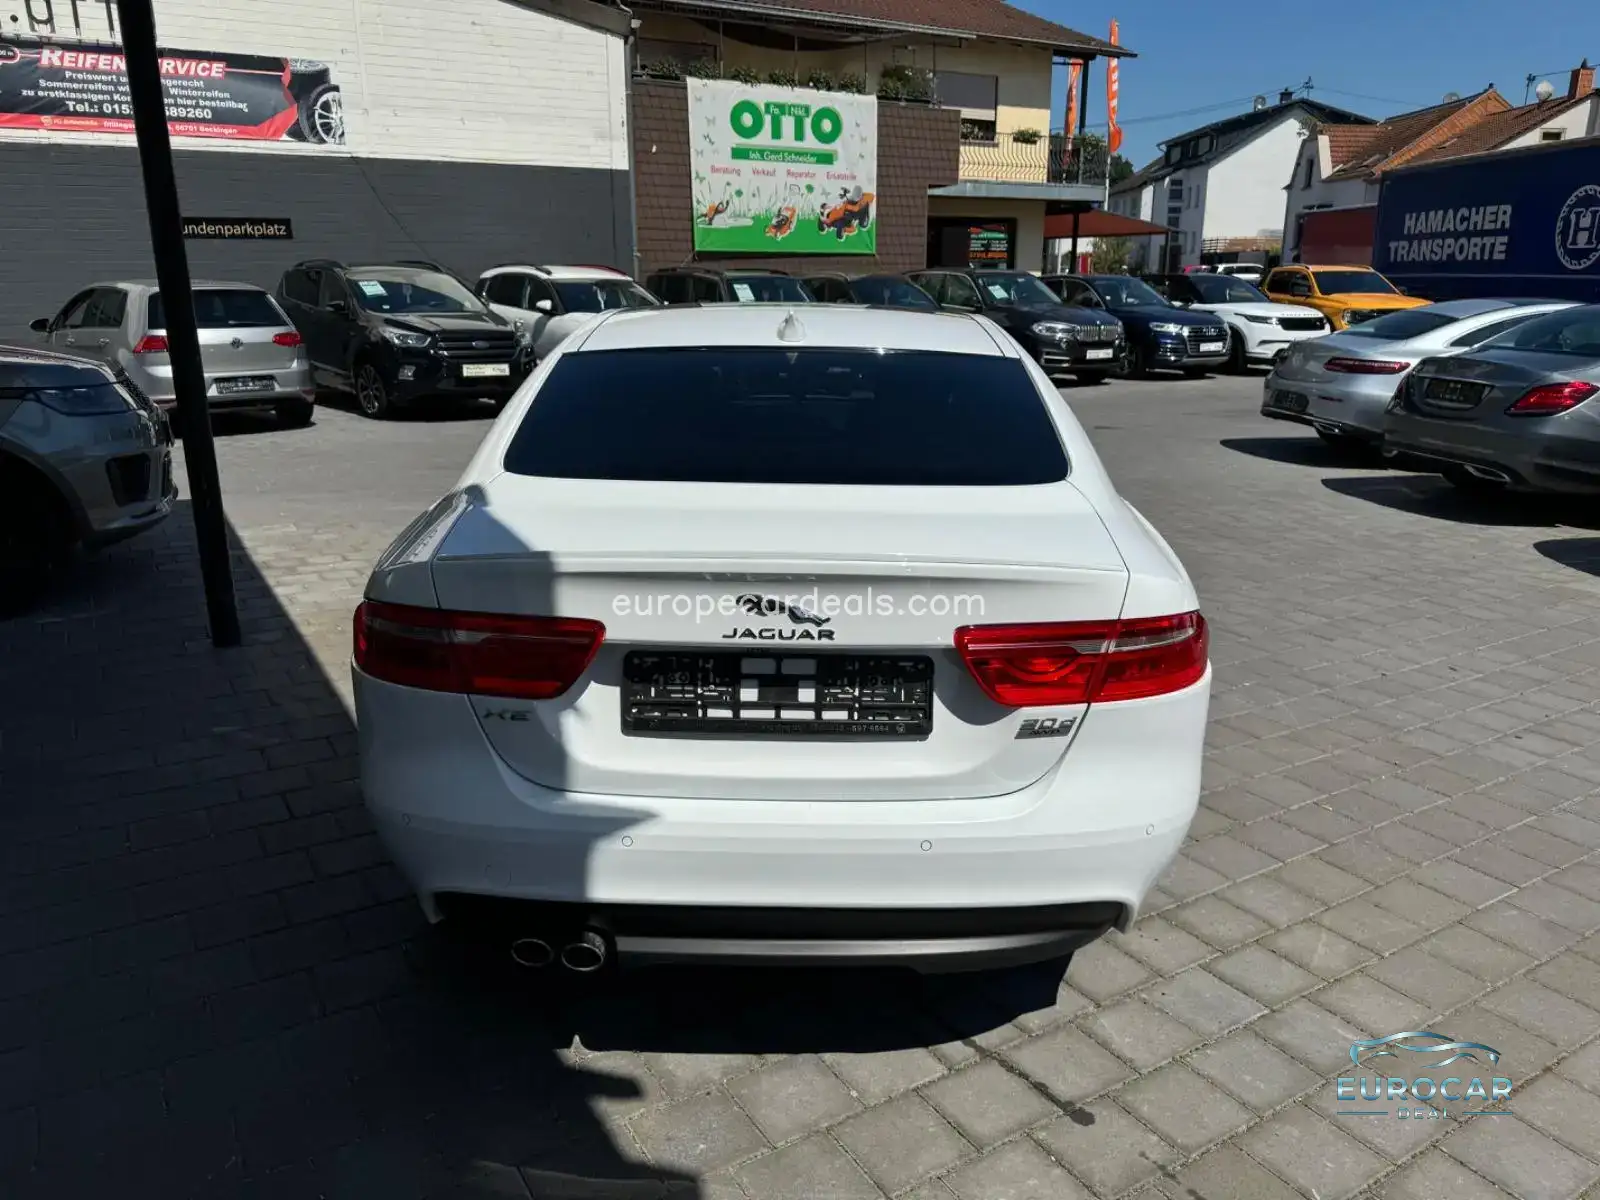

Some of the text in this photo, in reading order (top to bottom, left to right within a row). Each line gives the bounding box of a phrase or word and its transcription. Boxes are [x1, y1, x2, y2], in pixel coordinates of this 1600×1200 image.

[66, 101, 99, 113] Tel.:
[729, 99, 844, 144] OTTO
[1403, 204, 1512, 235] HAMACHER
[1389, 235, 1509, 262] TRANSPORTE
[722, 627, 835, 641] JAGUAR
